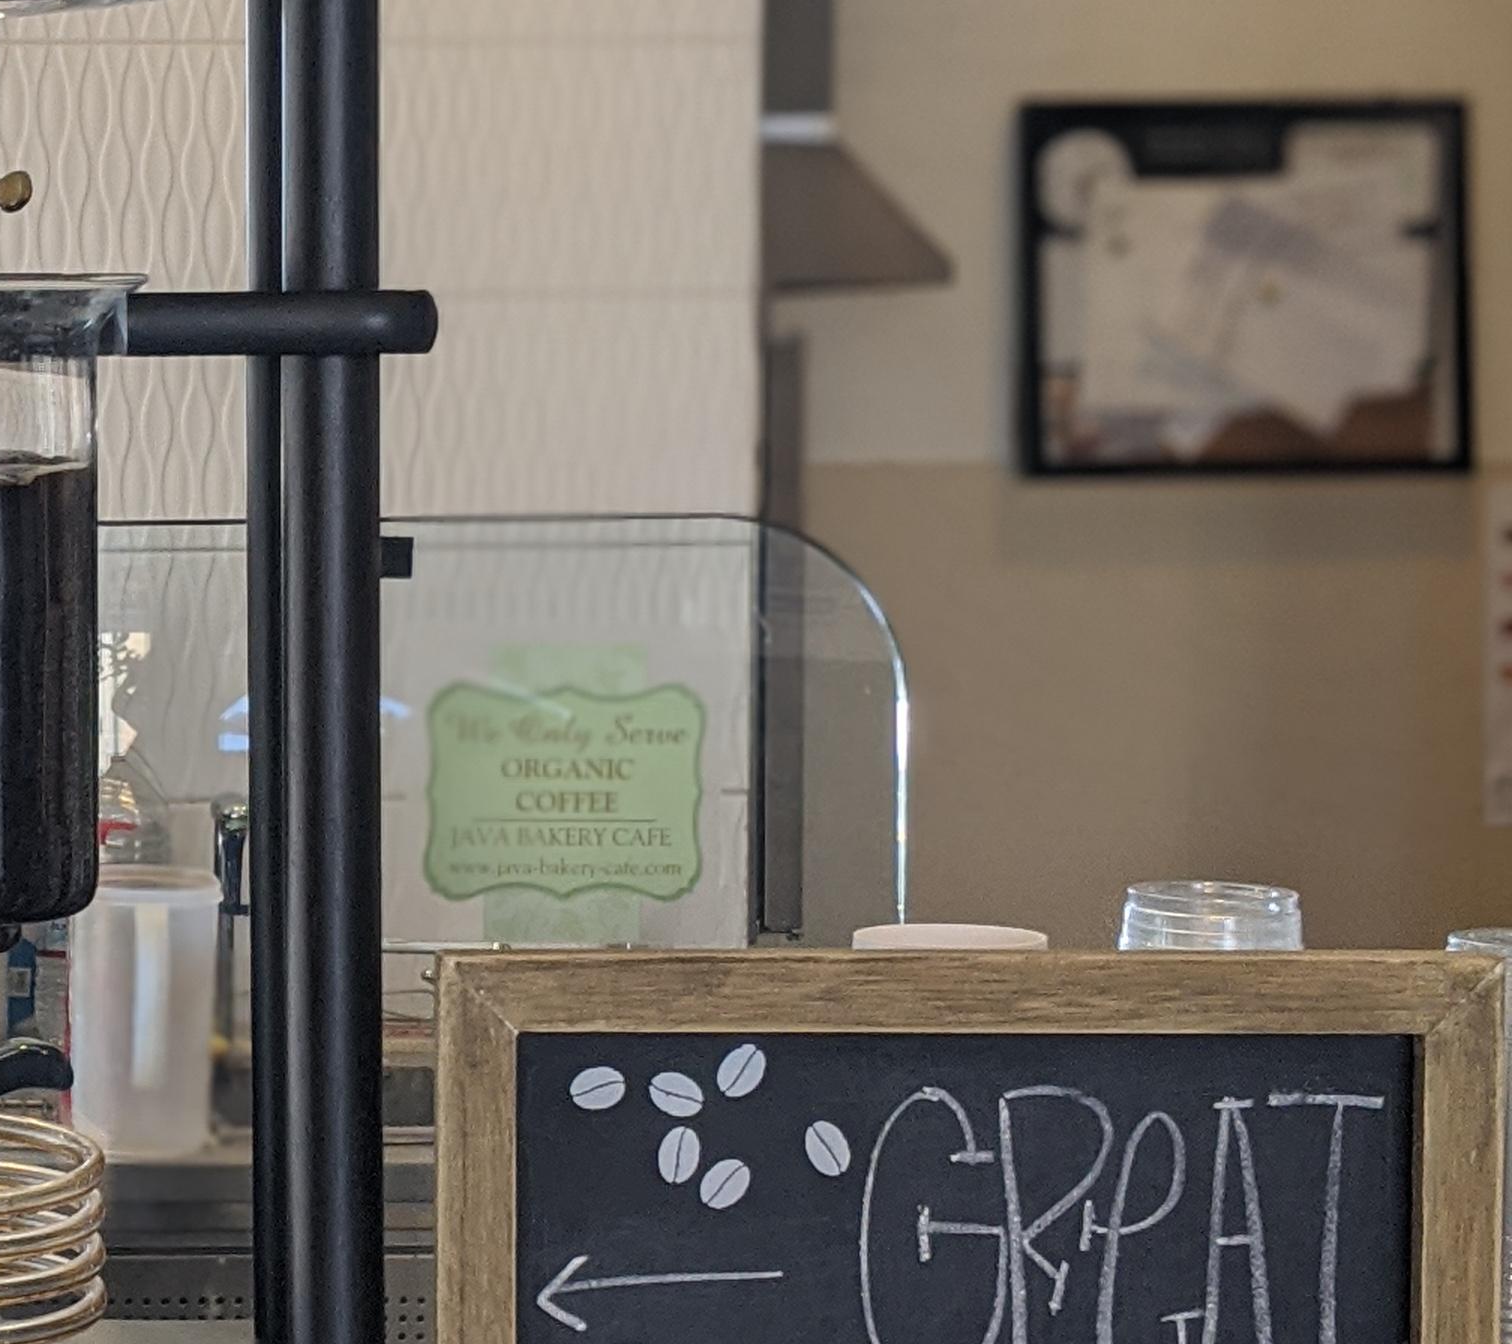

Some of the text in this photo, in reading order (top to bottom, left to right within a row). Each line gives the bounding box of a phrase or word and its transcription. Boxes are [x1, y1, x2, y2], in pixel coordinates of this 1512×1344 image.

[500, 758, 636, 781] ORGANIC
[515, 790, 620, 814] COFFEE
[450, 826, 673, 849] JAVA BAKERY CAFE
